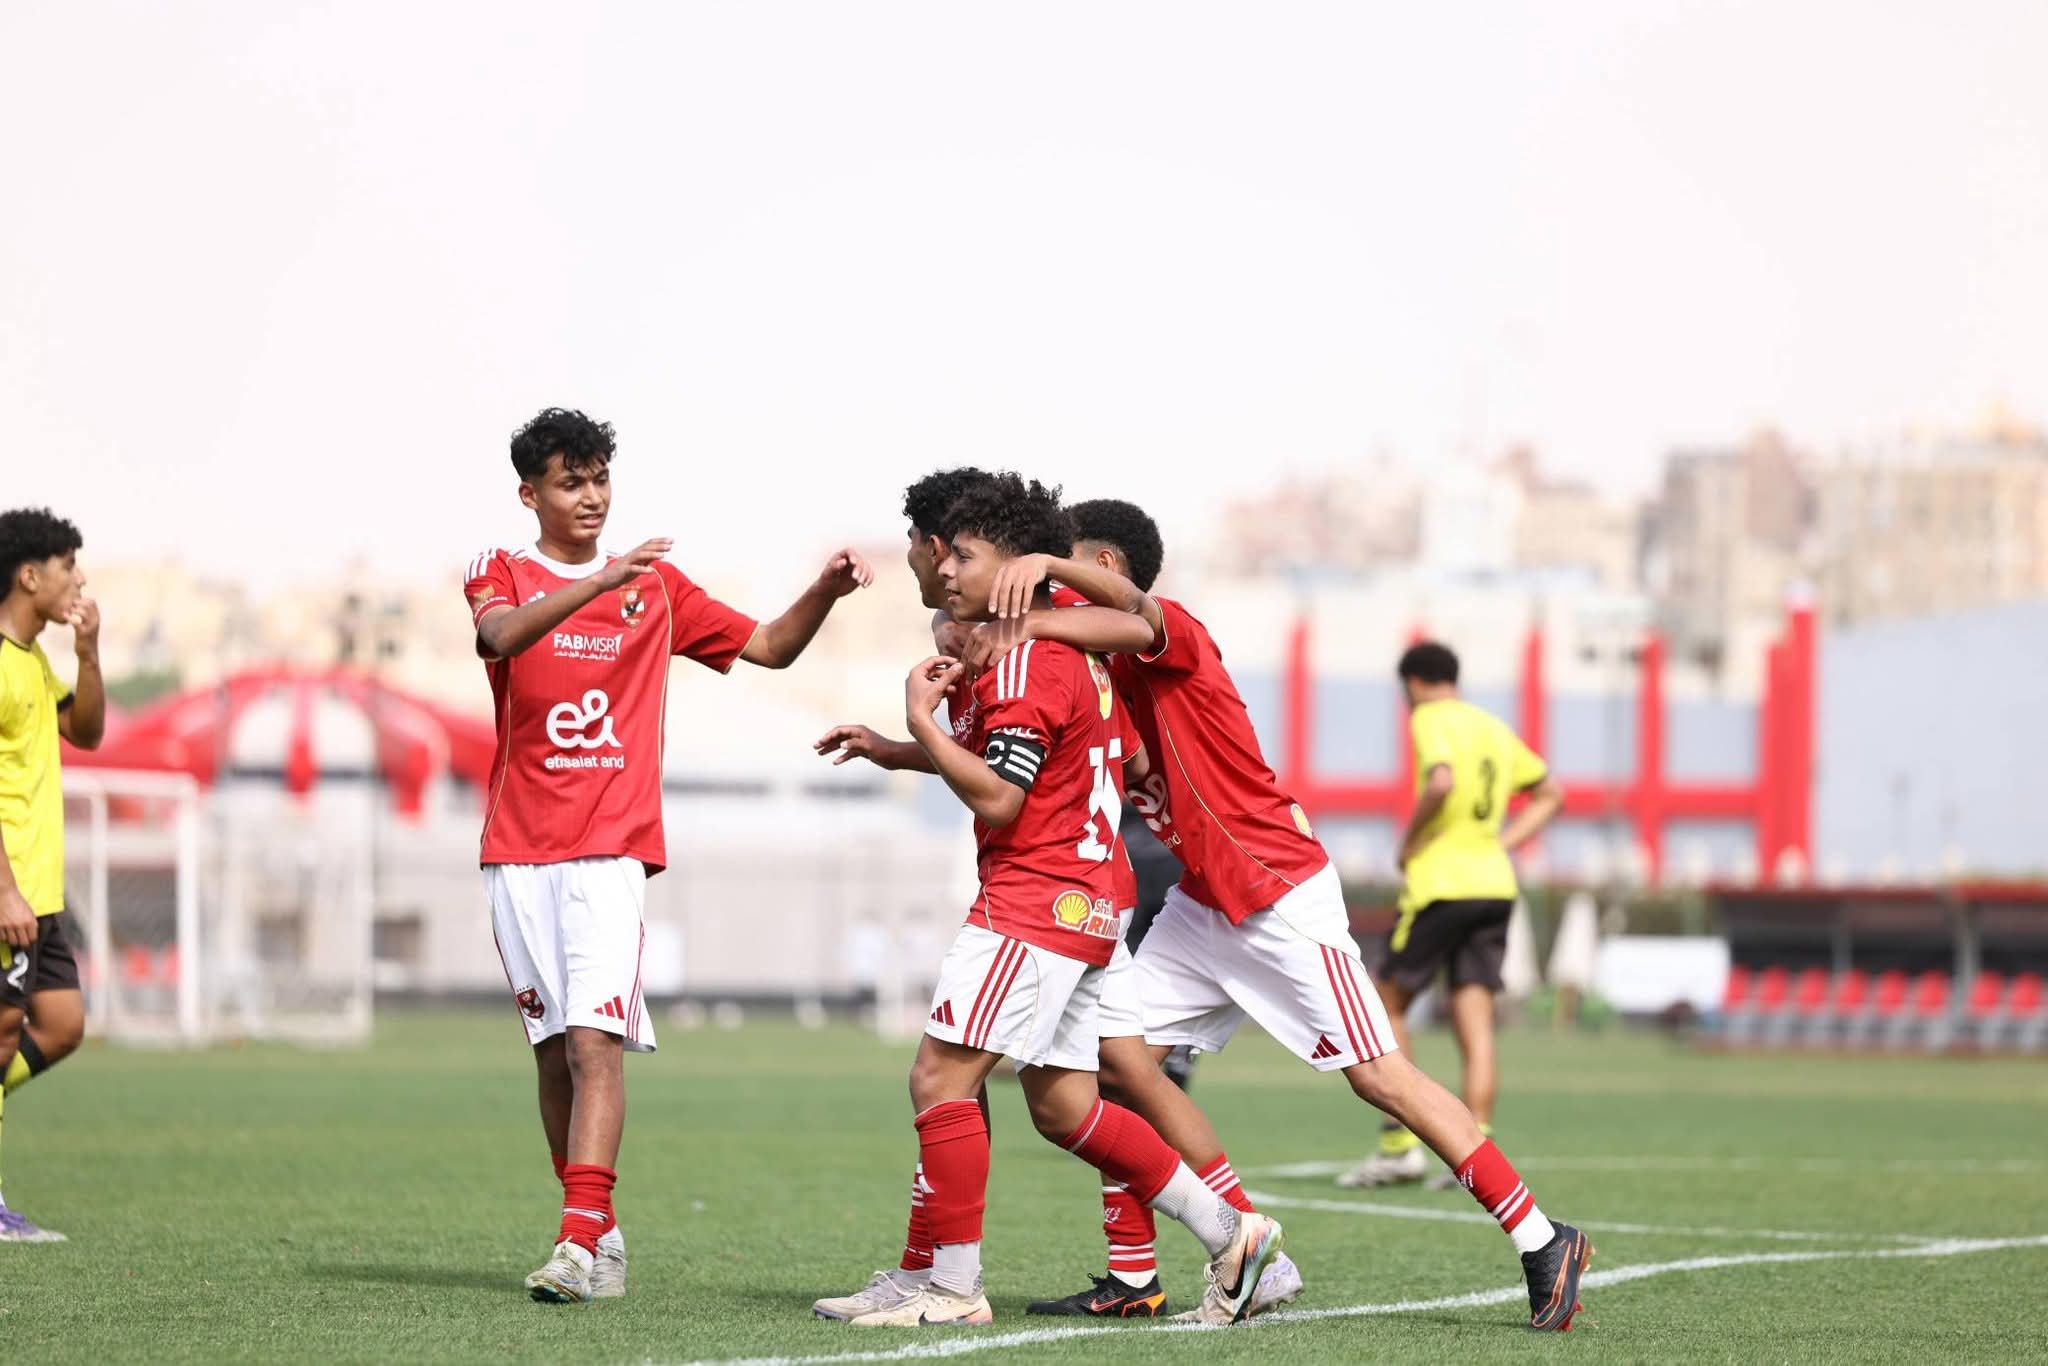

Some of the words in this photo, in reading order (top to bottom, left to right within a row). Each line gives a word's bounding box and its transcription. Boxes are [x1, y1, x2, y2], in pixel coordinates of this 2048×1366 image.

[553, 632, 617, 654] FABMISR
[546, 688, 624, 749] e&
[545, 754, 598, 770] etisalat
[600, 755, 625, 769] and
[985, 740, 1005, 765] C
[1473, 756, 1497, 821] 3
[7, 951, 29, 991] 2
